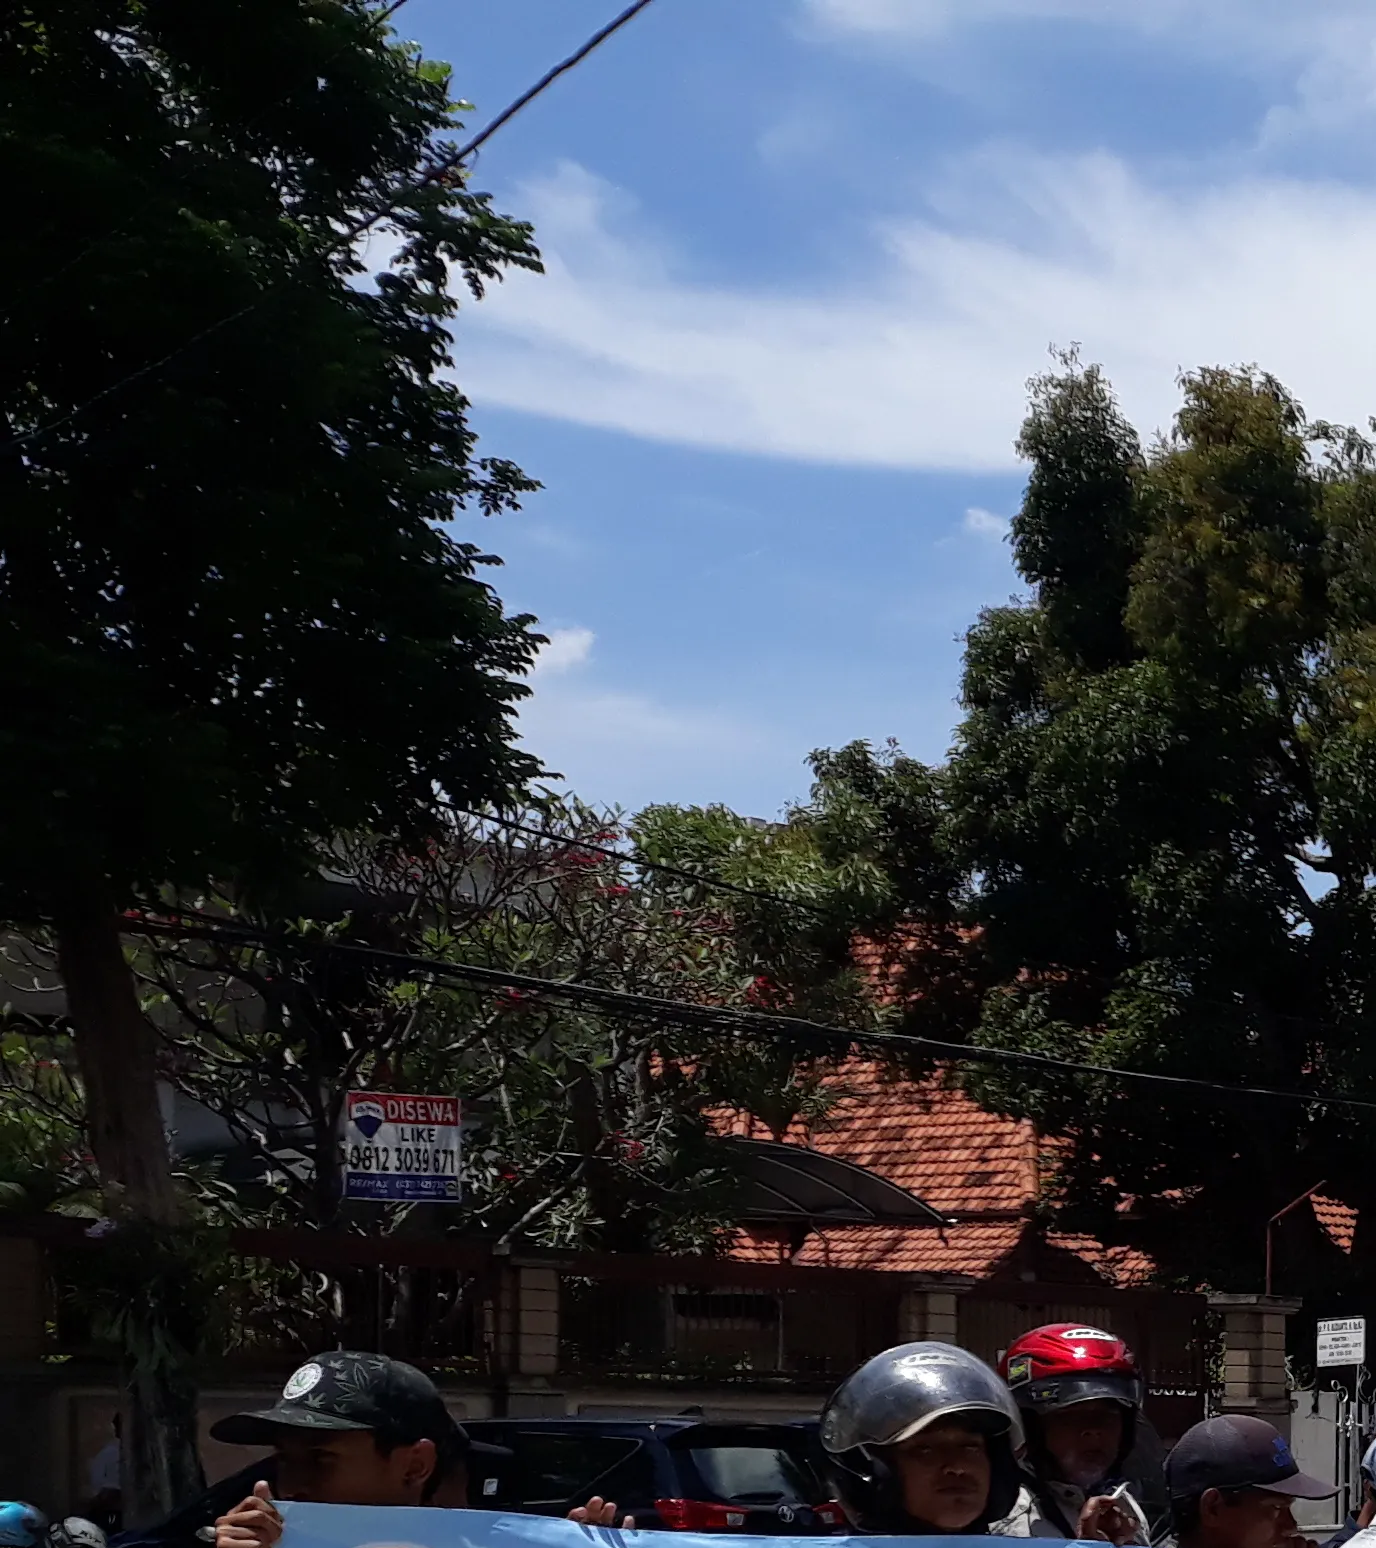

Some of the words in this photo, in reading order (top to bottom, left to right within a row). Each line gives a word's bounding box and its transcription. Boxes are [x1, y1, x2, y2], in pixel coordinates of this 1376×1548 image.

[387, 1099, 454, 1122] DISEWA
[400, 1127, 436, 1143] LIKE
[350, 1144, 390, 1172] 0812
[394, 1147, 430, 1172] 3039
[433, 1148, 455, 1174] 671
